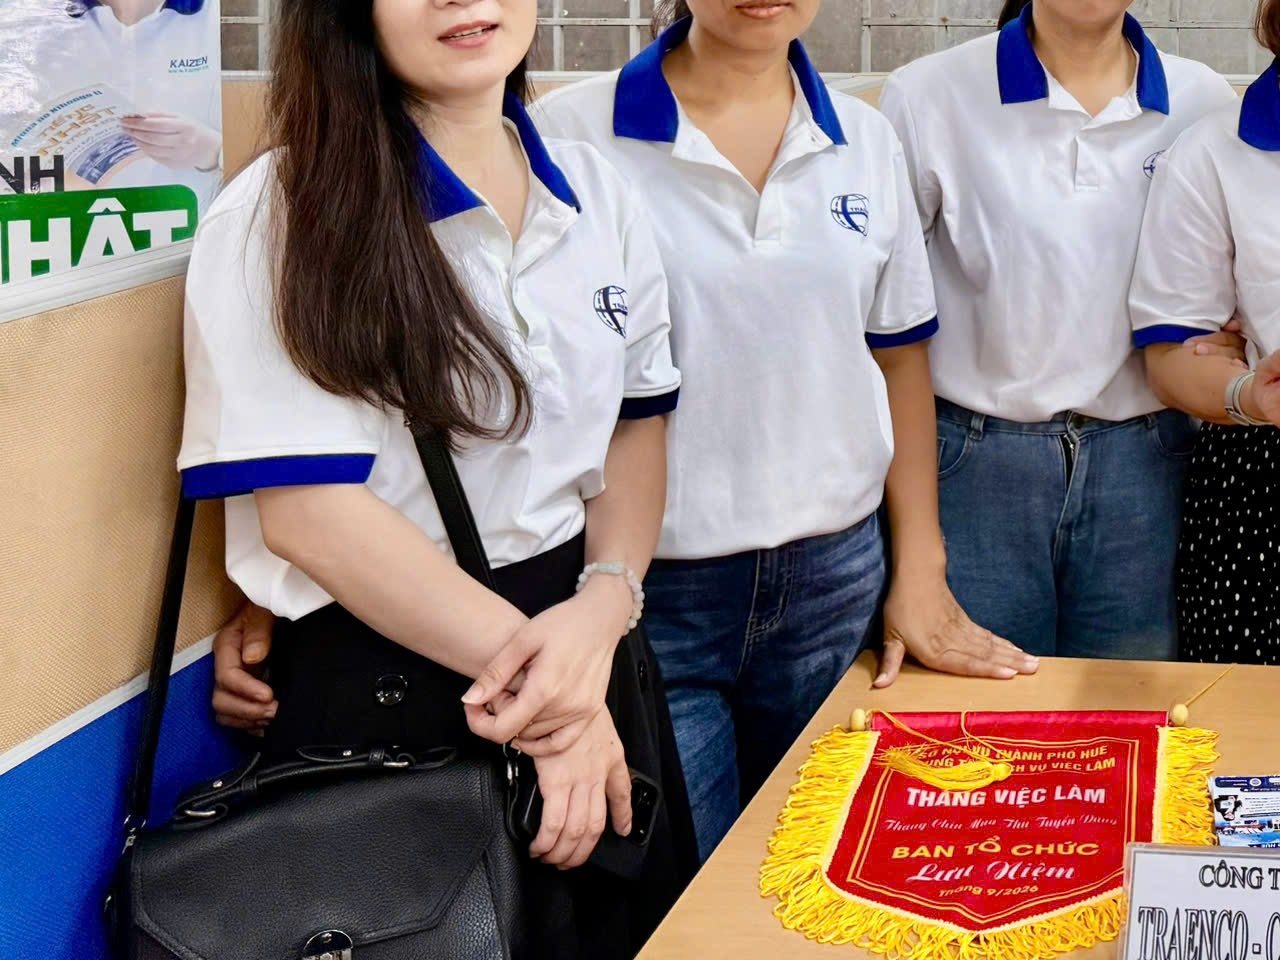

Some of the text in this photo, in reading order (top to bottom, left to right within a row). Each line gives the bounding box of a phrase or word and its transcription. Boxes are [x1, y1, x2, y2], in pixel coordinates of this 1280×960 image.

[169, 55, 208, 68] KAIZEN
[994, 787, 1047, 809] VIỆC
[1054, 784, 1106, 804] LÀM
[892, 835, 1100, 859] BAN TỔ CHỨC
[1199, 860, 1263, 889] CÔNG
[986, 886, 1039, 897] 9/2026
[1138, 906, 1249, 960] TRAENCO
